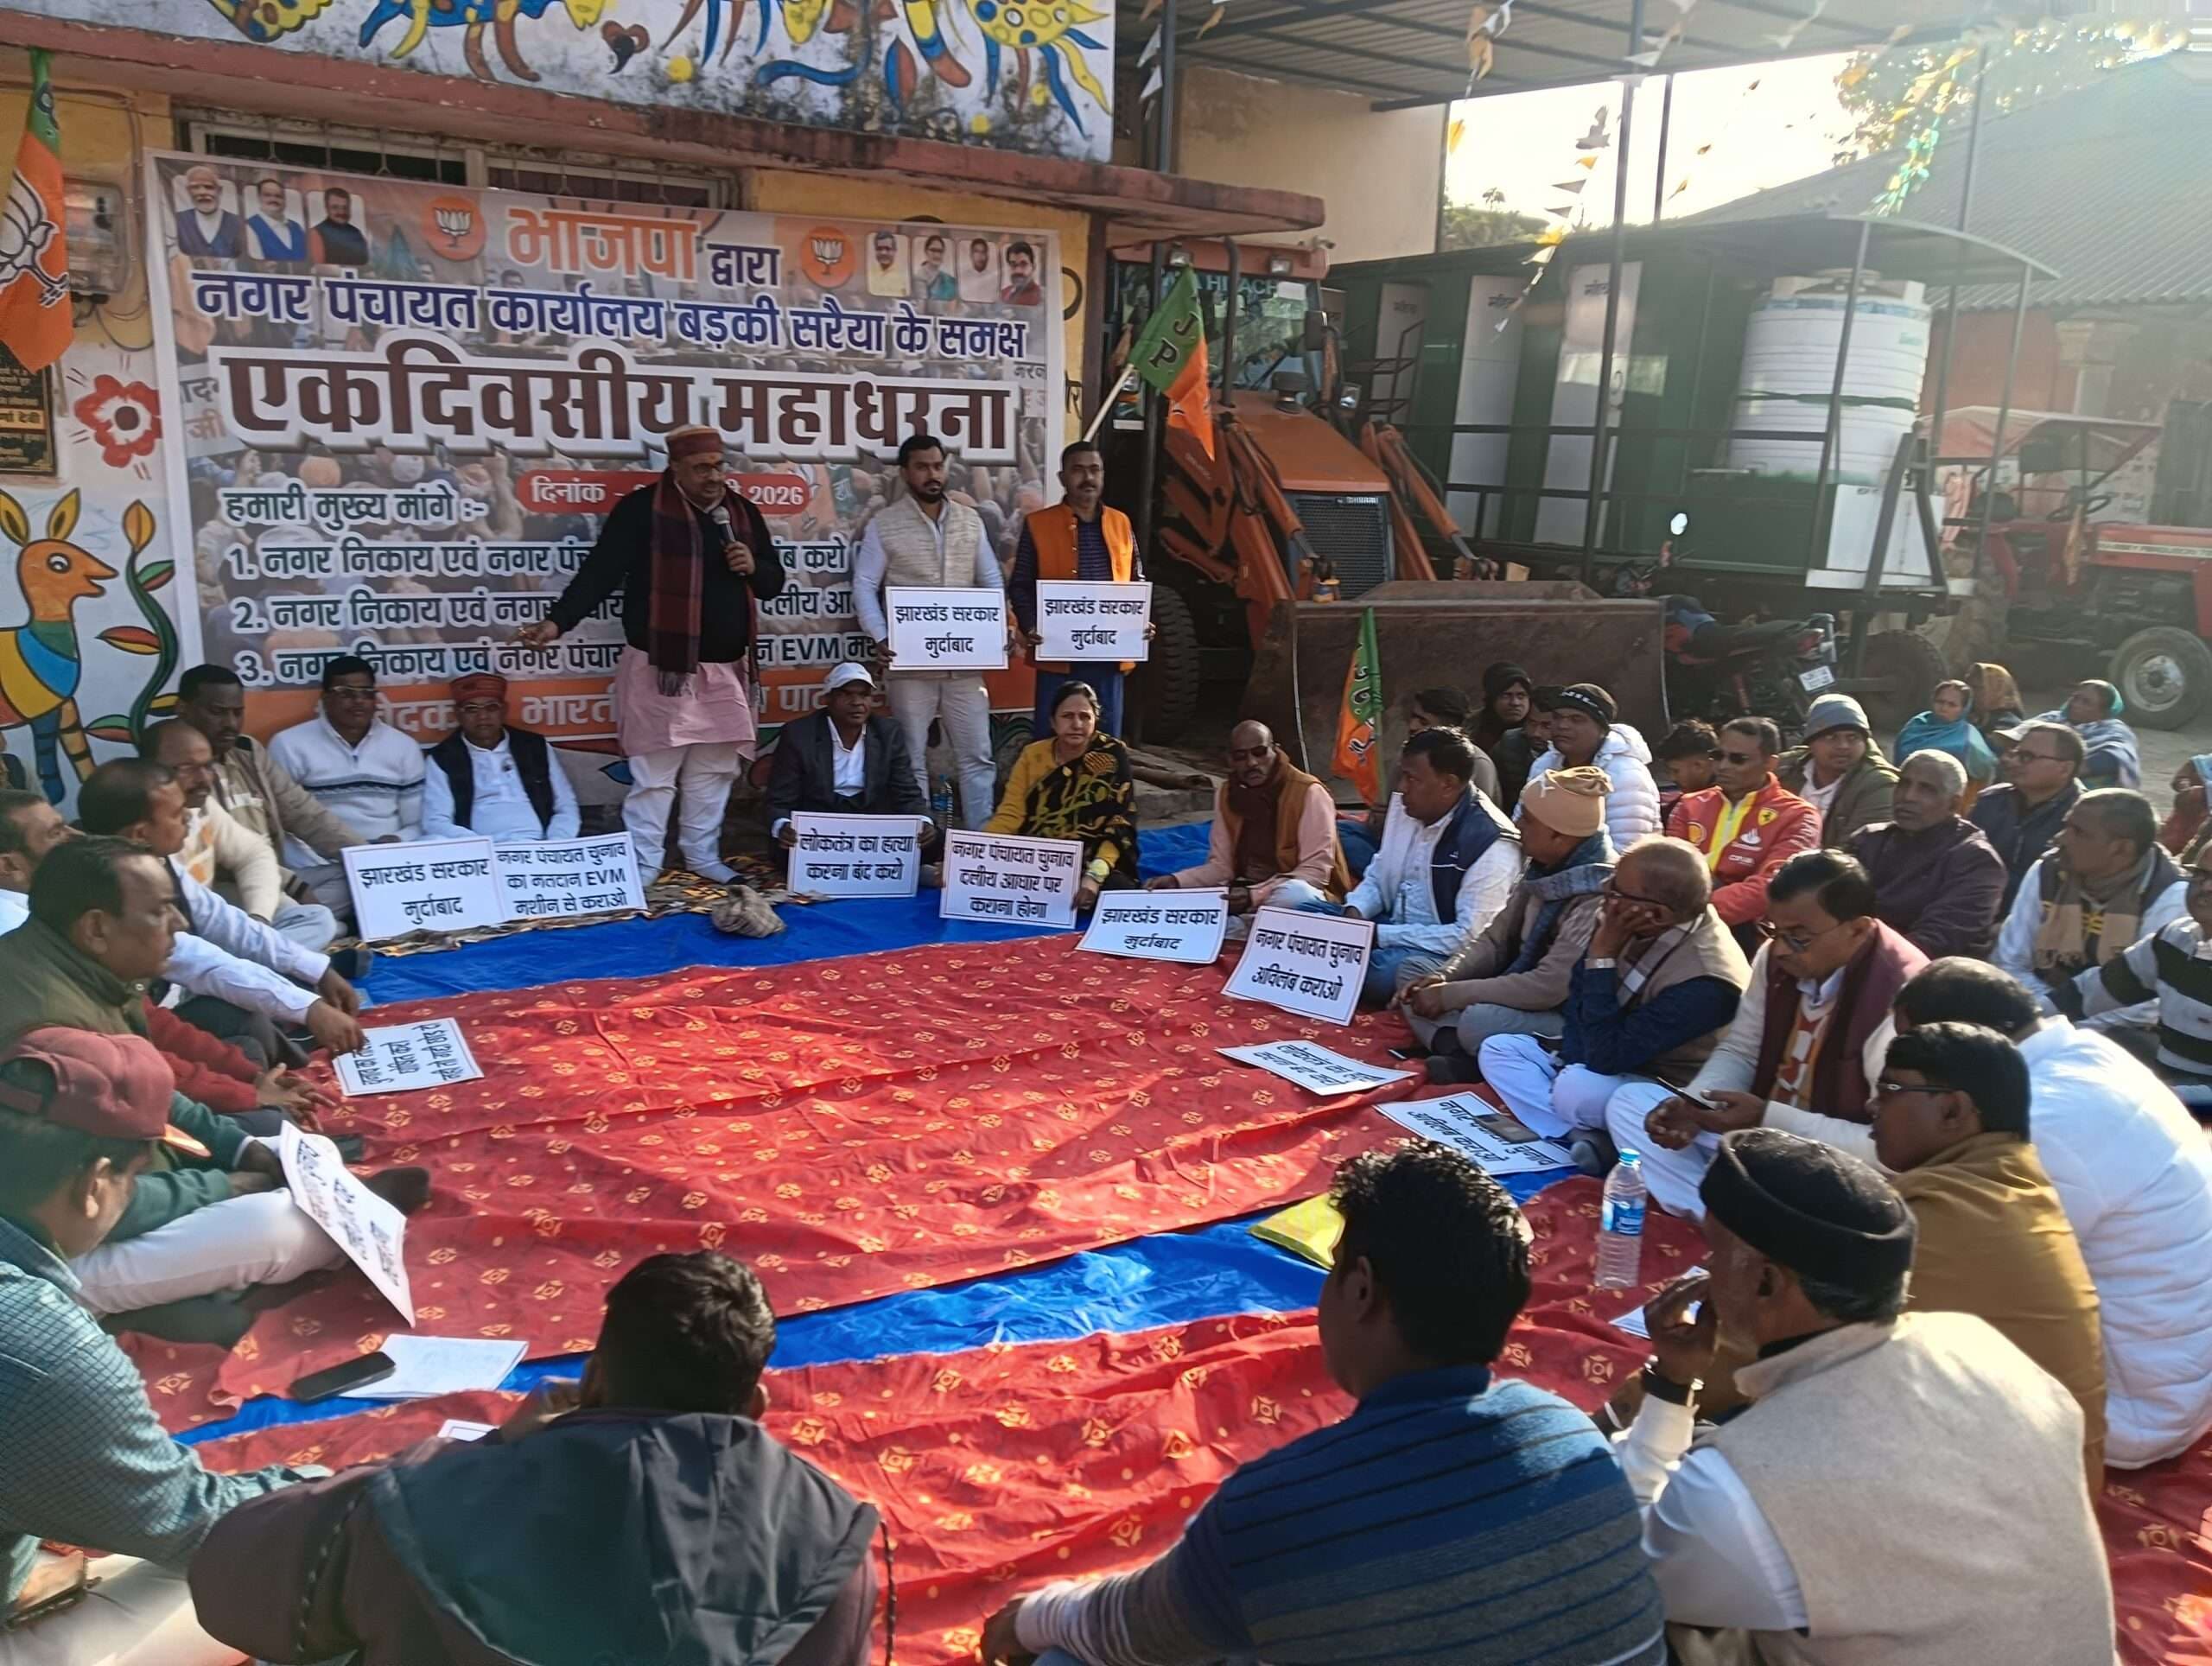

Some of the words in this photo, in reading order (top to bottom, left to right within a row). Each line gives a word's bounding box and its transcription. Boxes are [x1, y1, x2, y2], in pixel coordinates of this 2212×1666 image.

[508, 210, 697, 280] भाजपा
[708, 243, 779, 286] द्वारा
[193, 272, 311, 320] नगर
[325, 272, 479, 328] पंचायत
[489, 282, 664, 339] कार्यालय
[676, 296, 779, 348] बड़की
[790, 296, 884, 352] सरैया
[893, 304, 930, 353] के
[940, 317, 1026, 358] समक्ष
[220, 338, 694, 441] एकदिवसीय
[713, 378, 1011, 449] महाधरना
[531, 475, 607, 503] दिनांक
[748, 486, 804, 506] 2026
[223, 483, 306, 522] हमारी
[314, 493, 389, 531] मुख्य
[394, 484, 454, 520] मांगे
[229, 548, 256, 575] 1.
[262, 546, 334, 574] नगर
[341, 537, 435, 574] निकाय
[440, 539, 480, 572] एवं
[485, 546, 552, 573] नगर
[800, 536, 848, 569] करो
[234, 601, 264, 629] 2.
[271, 600, 342, 628] नगर
[349, 588, 442, 626] निकाय
[448, 591, 487, 622] एवं
[894, 603, 949, 624] झारखंड
[951, 606, 1001, 623] सरकार
[1043, 596, 1096, 616] झारखंड
[1098, 599, 1146, 615] सरकार
[782, 638, 841, 662] EVM
[925, 633, 975, 658] मुर्दाबाद
[1071, 625, 1118, 651] मुर्दाबाद
[240, 655, 270, 683] 3.
[276, 651, 346, 680] नग
[452, 640, 491, 672] एवं
[496, 645, 562, 671] नगर
[495, 850, 533, 864] नगर
[535, 847, 585, 863] पंचायत
[586, 842, 627, 865] चुनाव
[799, 827, 855, 853] लोकतंत्र
[858, 836, 880, 853] का
[881, 836, 914, 854] हत्या
[805, 863, 850, 881] करना
[852, 861, 873, 881] बंद
[875, 857, 905, 880] करो
[951, 841, 987, 859] नगर
[988, 842, 1036, 864] पंचायत
[1037, 849, 1076, 872] चुनाव
[358, 862, 426, 888] झारखंड
[429, 858, 491, 880] सरकार
[505, 874, 527, 889] का
[585, 868, 627, 887] EVM
[959, 865, 999, 887] दलीय
[1000, 873, 1041, 892] आधार
[1043, 876, 1064, 893] पर
[401, 893, 464, 925] मुर्दाबाद
[563, 892, 578, 912] से
[579, 887, 628, 908] कराओ
[1016, 895, 1048, 919] होगा
[1102, 906, 1163, 924] झारखंड
[1165, 909, 1222, 925] सरकार
[1124, 933, 1183, 950] मुर्दाबाद
[1255, 928, 1287, 950] नगर
[1287, 930, 1329, 958] पंचायत
[1329, 941, 1365, 968] चुनाव
[1251, 963, 1300, 991] अविलंब
[1300, 976, 1344, 1001] कराओ
